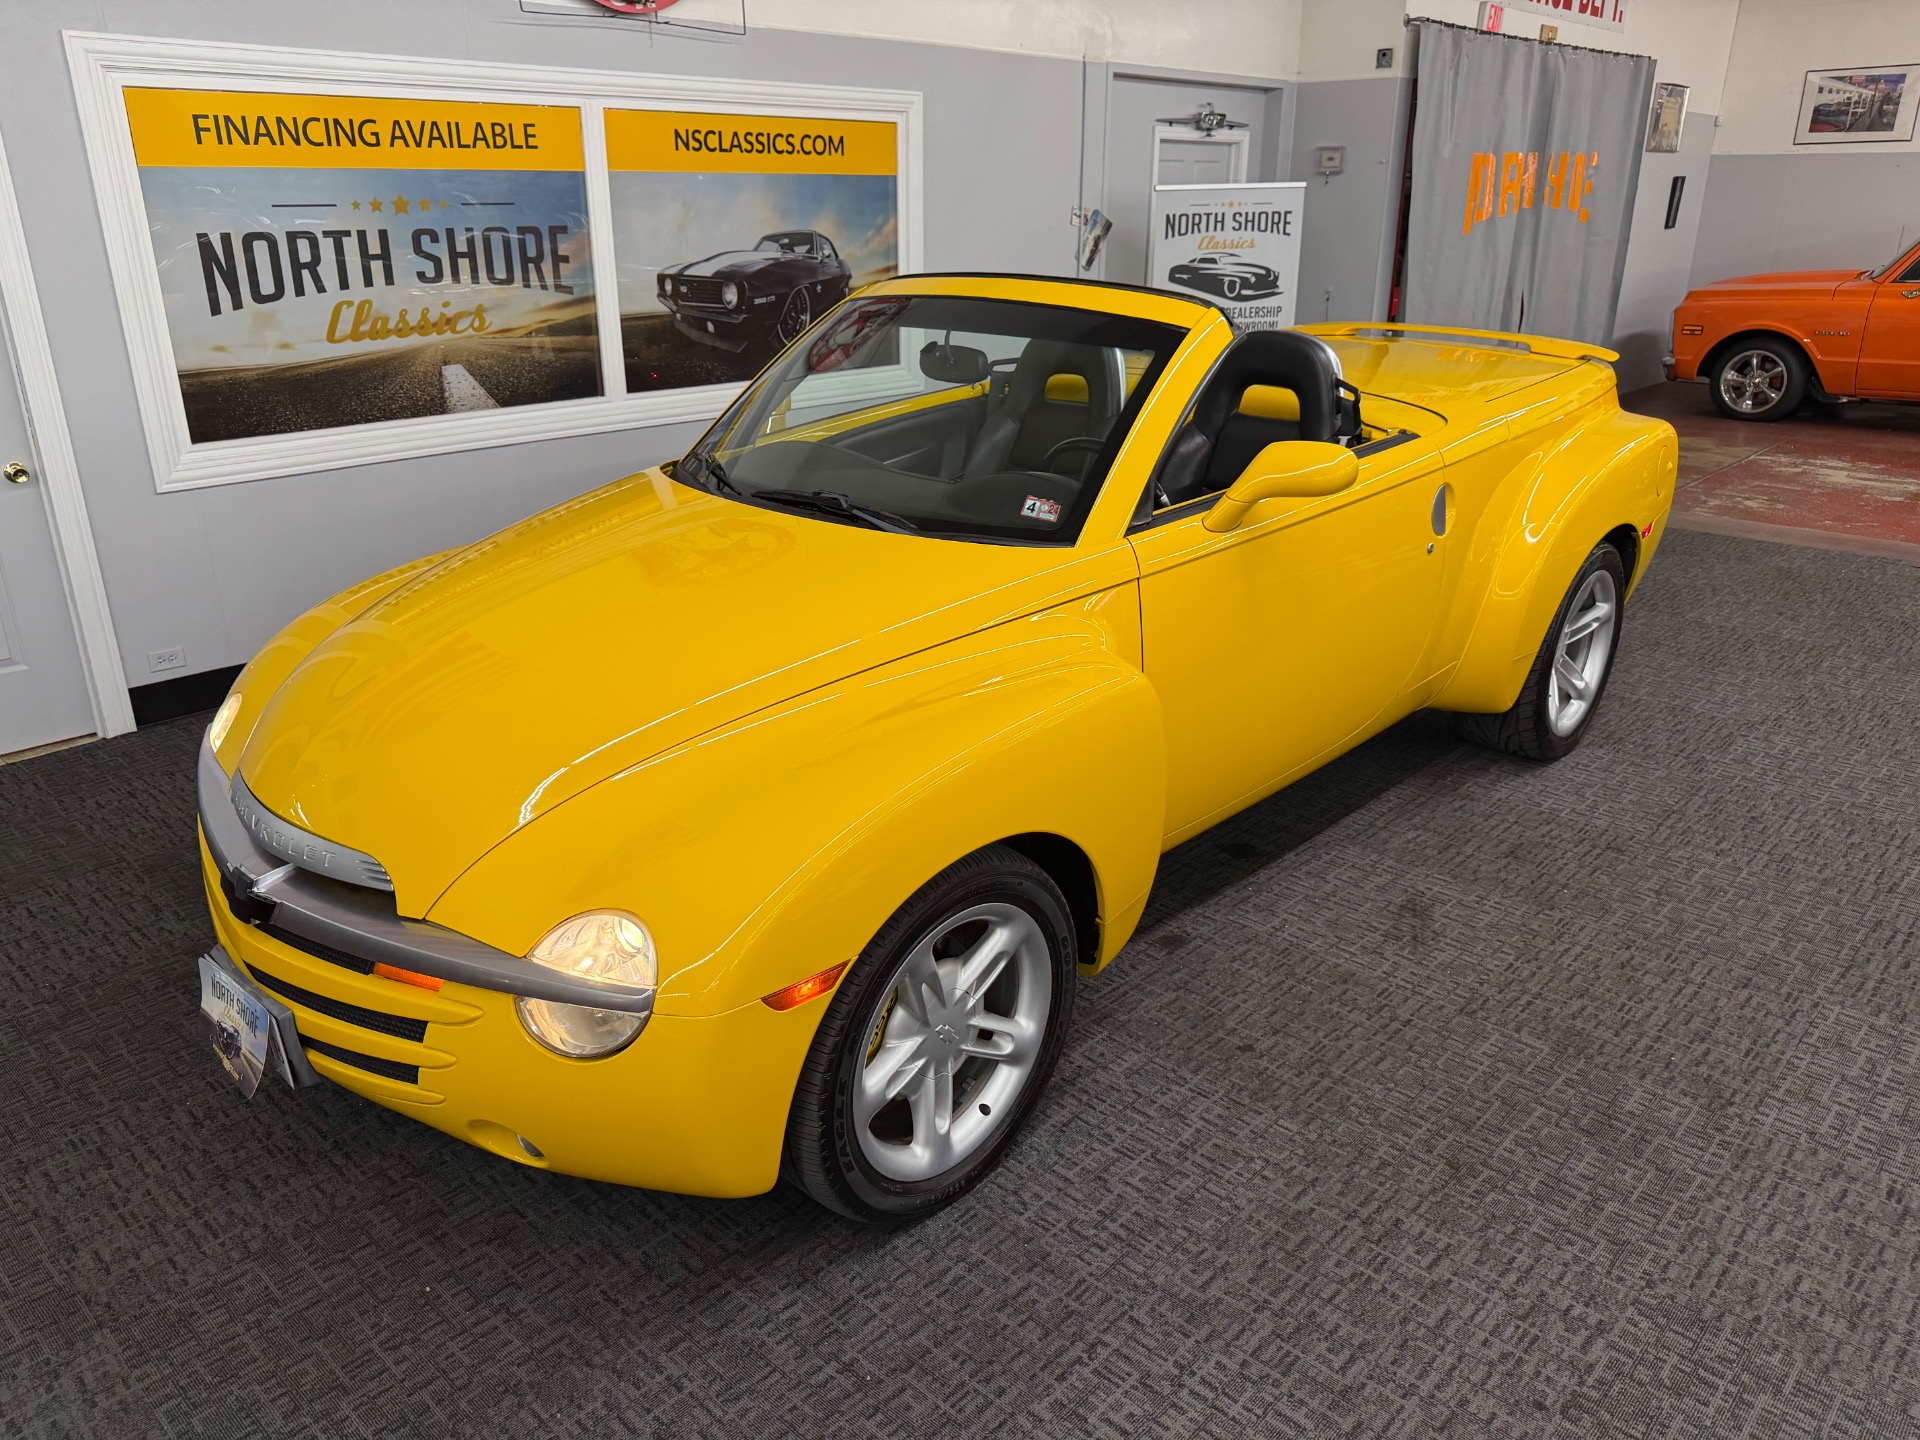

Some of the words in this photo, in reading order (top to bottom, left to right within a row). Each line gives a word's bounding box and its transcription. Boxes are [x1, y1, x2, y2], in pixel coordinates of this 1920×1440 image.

[192, 114, 381, 148] FINANCING
[389, 119, 539, 150] AVAILABLE
[674, 128, 845, 156] NSCLASSICS.COM
[1164, 212, 1226, 240] NORTH
[1232, 211, 1293, 237] SHORE
[1198, 235, 1257, 250] Classics
[196, 228, 395, 317] NORTH
[411, 225, 574, 295] SHORE
[325, 299, 493, 344] Classics
[1026, 502, 1037, 513] 4
[211, 975, 235, 1009] NORTH
[236, 998, 260, 1038] SHORE
